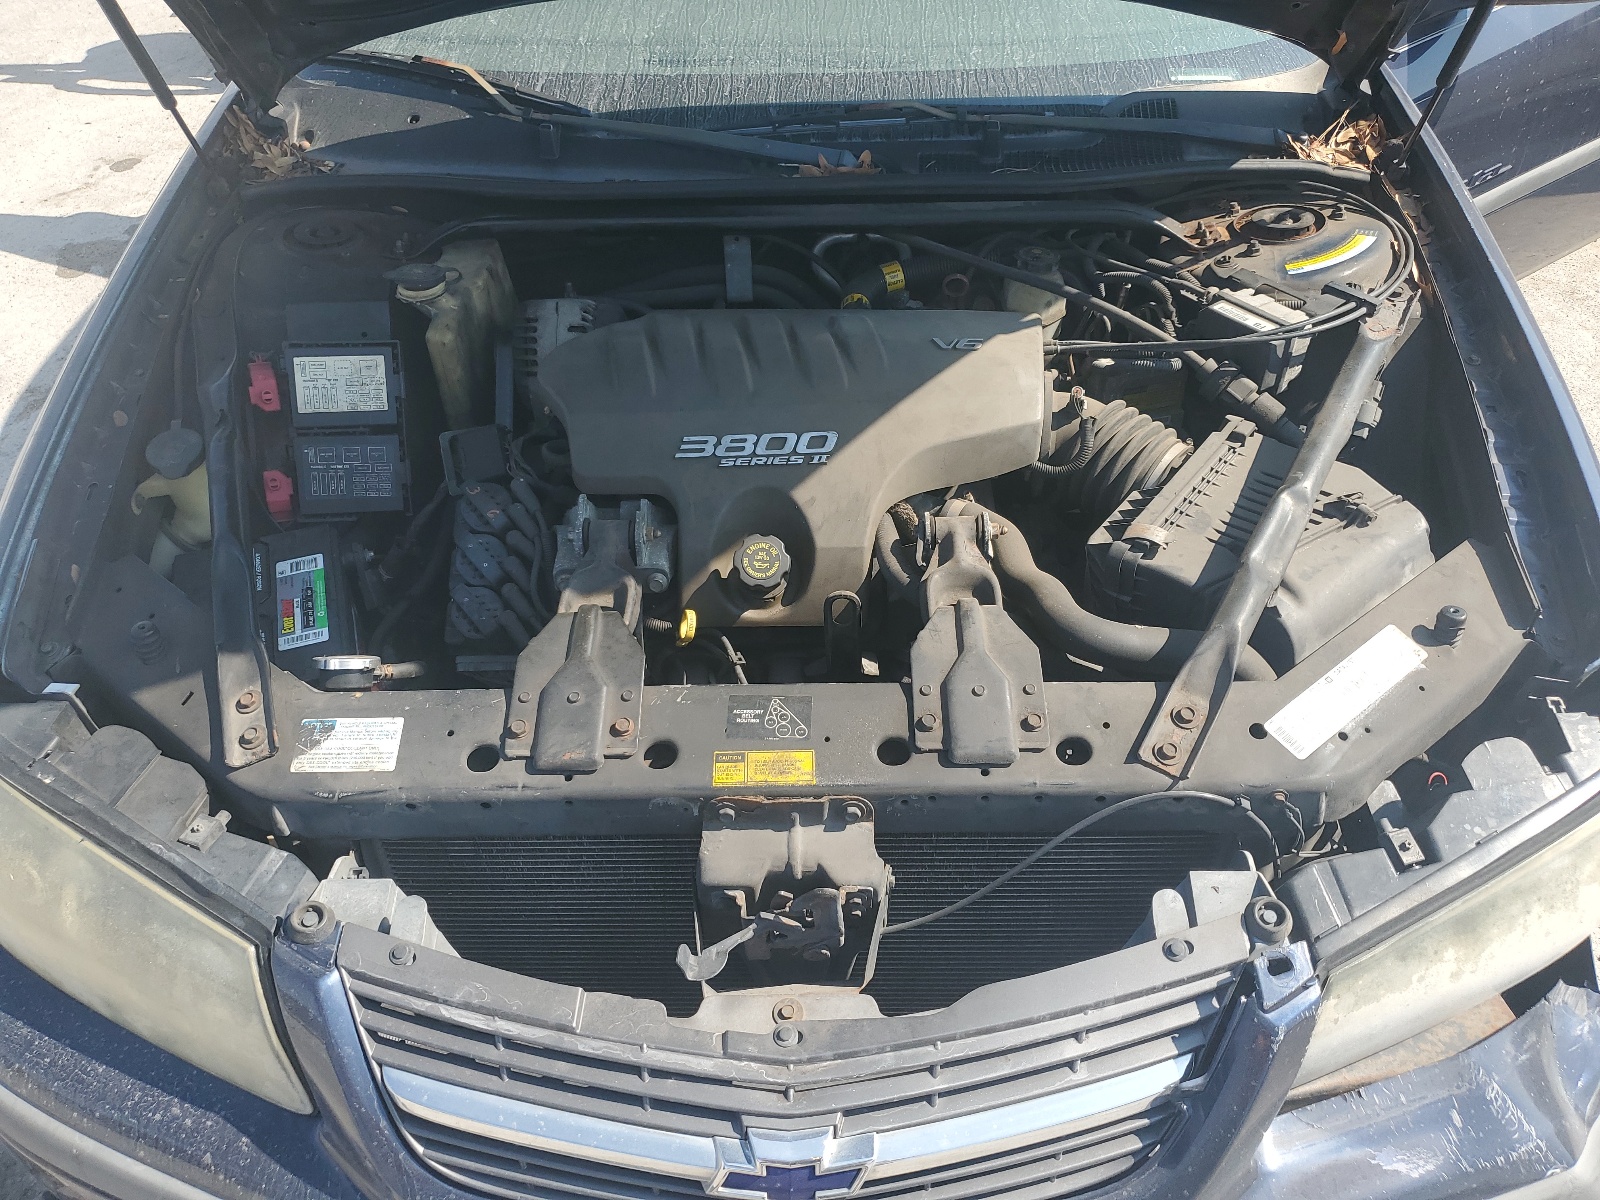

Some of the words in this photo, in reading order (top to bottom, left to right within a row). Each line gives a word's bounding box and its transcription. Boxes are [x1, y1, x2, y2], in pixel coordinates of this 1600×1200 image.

[932, 337, 984, 351] V6
[675, 431, 839, 458] 3800
[718, 455, 805, 467] SERIES
[808, 454, 831, 465] II
[746, 542, 770, 555] ENGINE
[769, 547, 780, 558] OIL
